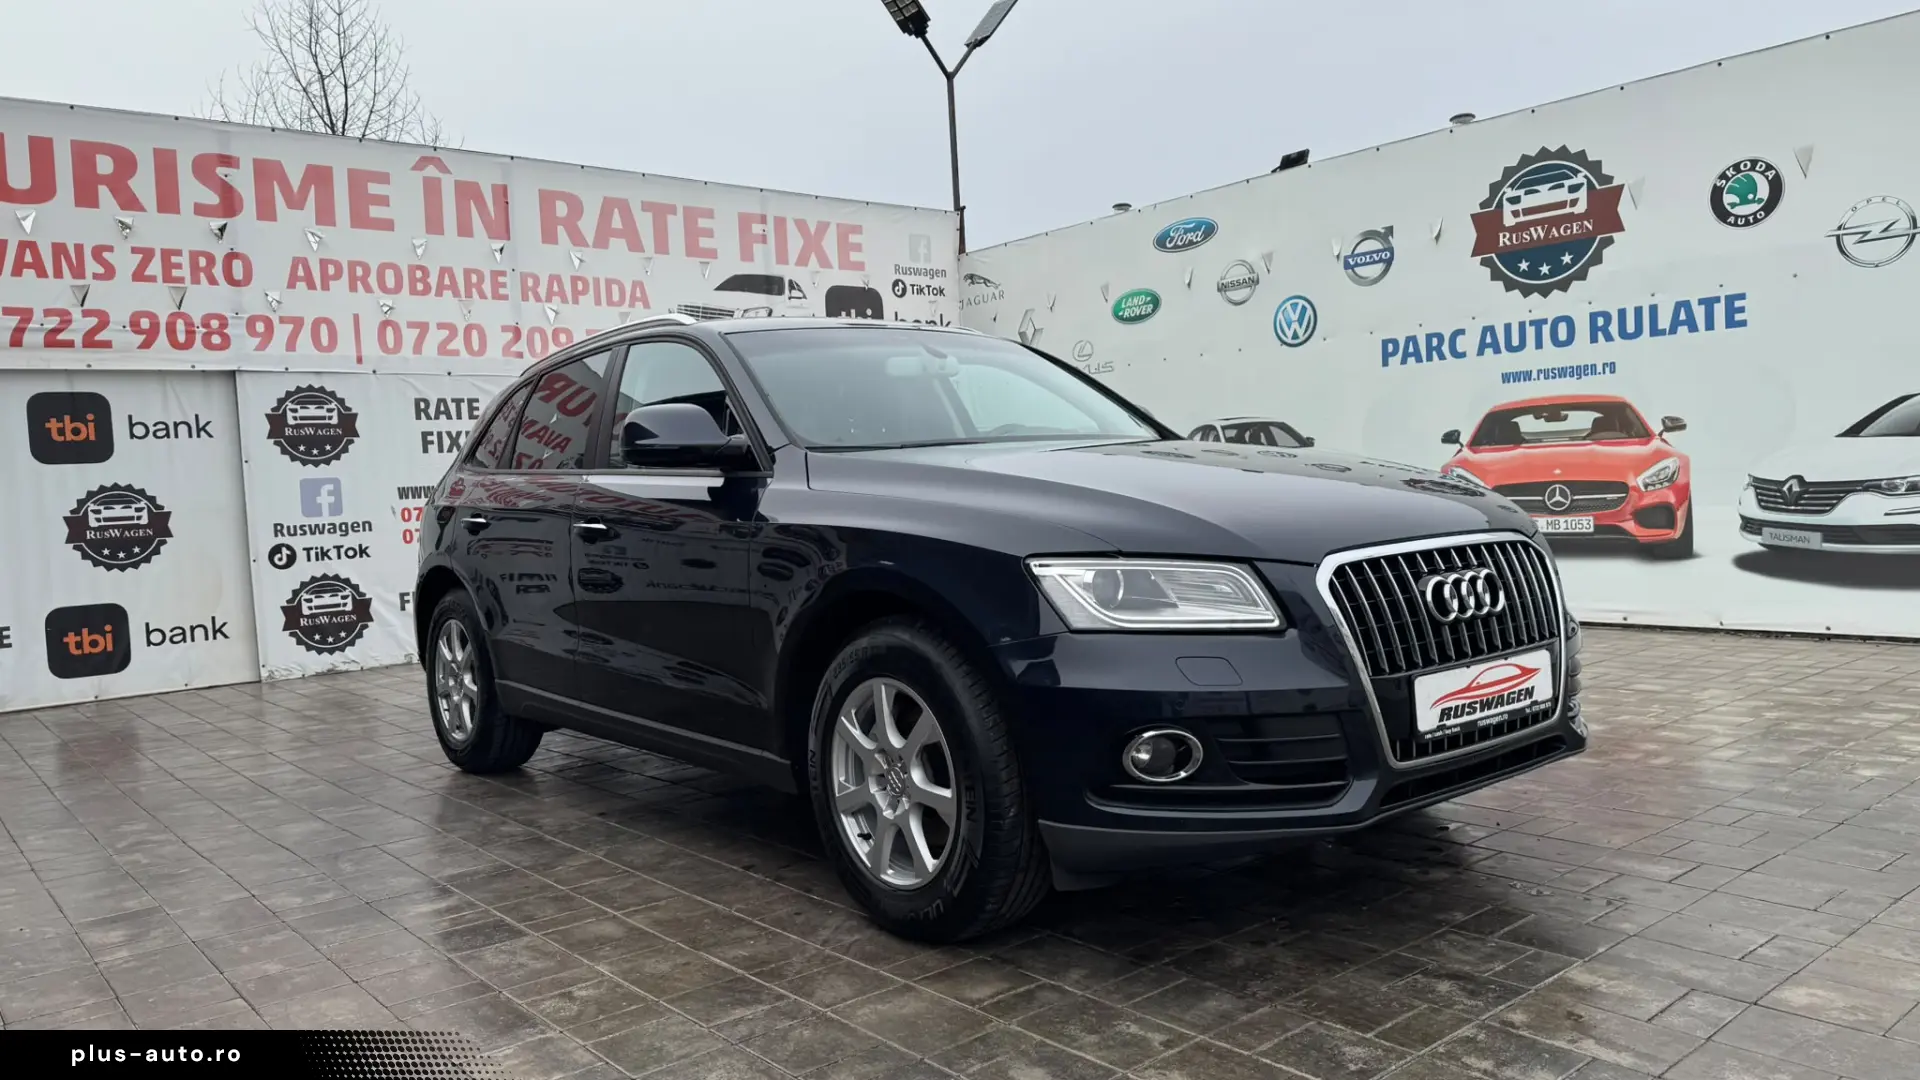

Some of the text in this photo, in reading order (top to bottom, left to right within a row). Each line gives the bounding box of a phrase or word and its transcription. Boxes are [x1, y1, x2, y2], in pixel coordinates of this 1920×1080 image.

[0, 132, 866, 272] URISME ÎN RATE FIXE
[1850, 197, 1902, 213] OPEL
[1727, 211, 1765, 225] AUTO
[1166, 222, 1204, 247] Ford
[1349, 250, 1391, 265] VOLVO
[0, 239, 652, 310] ANS ZERO APROBARE RAPIDA
[894, 263, 947, 280] Ruswagen
[1220, 275, 1256, 289] NISSAN
[910, 284, 946, 297] TikTok
[959, 289, 1006, 311] JAGUAR
[1121, 295, 1145, 309] LAND
[1123, 304, 1153, 318] ROVER
[128, 309, 232, 351] 908
[245, 313, 338, 353] 970
[377, 318, 488, 358] 0720
[1381, 292, 1749, 368] PARC AUTO RULATE
[1501, 361, 1617, 384] www.ruswagen.ro
[414, 397, 480, 421] RATE
[45, 413, 96, 442] tbi
[127, 414, 214, 440] bank
[273, 520, 373, 537] Ruswagen
[1546, 519, 1592, 530] MB 1053
[1769, 532, 1810, 543] TALISMAN
[303, 544, 371, 562] TikTok
[63, 624, 114, 655] tbi
[145, 616, 230, 647] bank
[1438, 686, 1535, 723] RUSWAGEN
